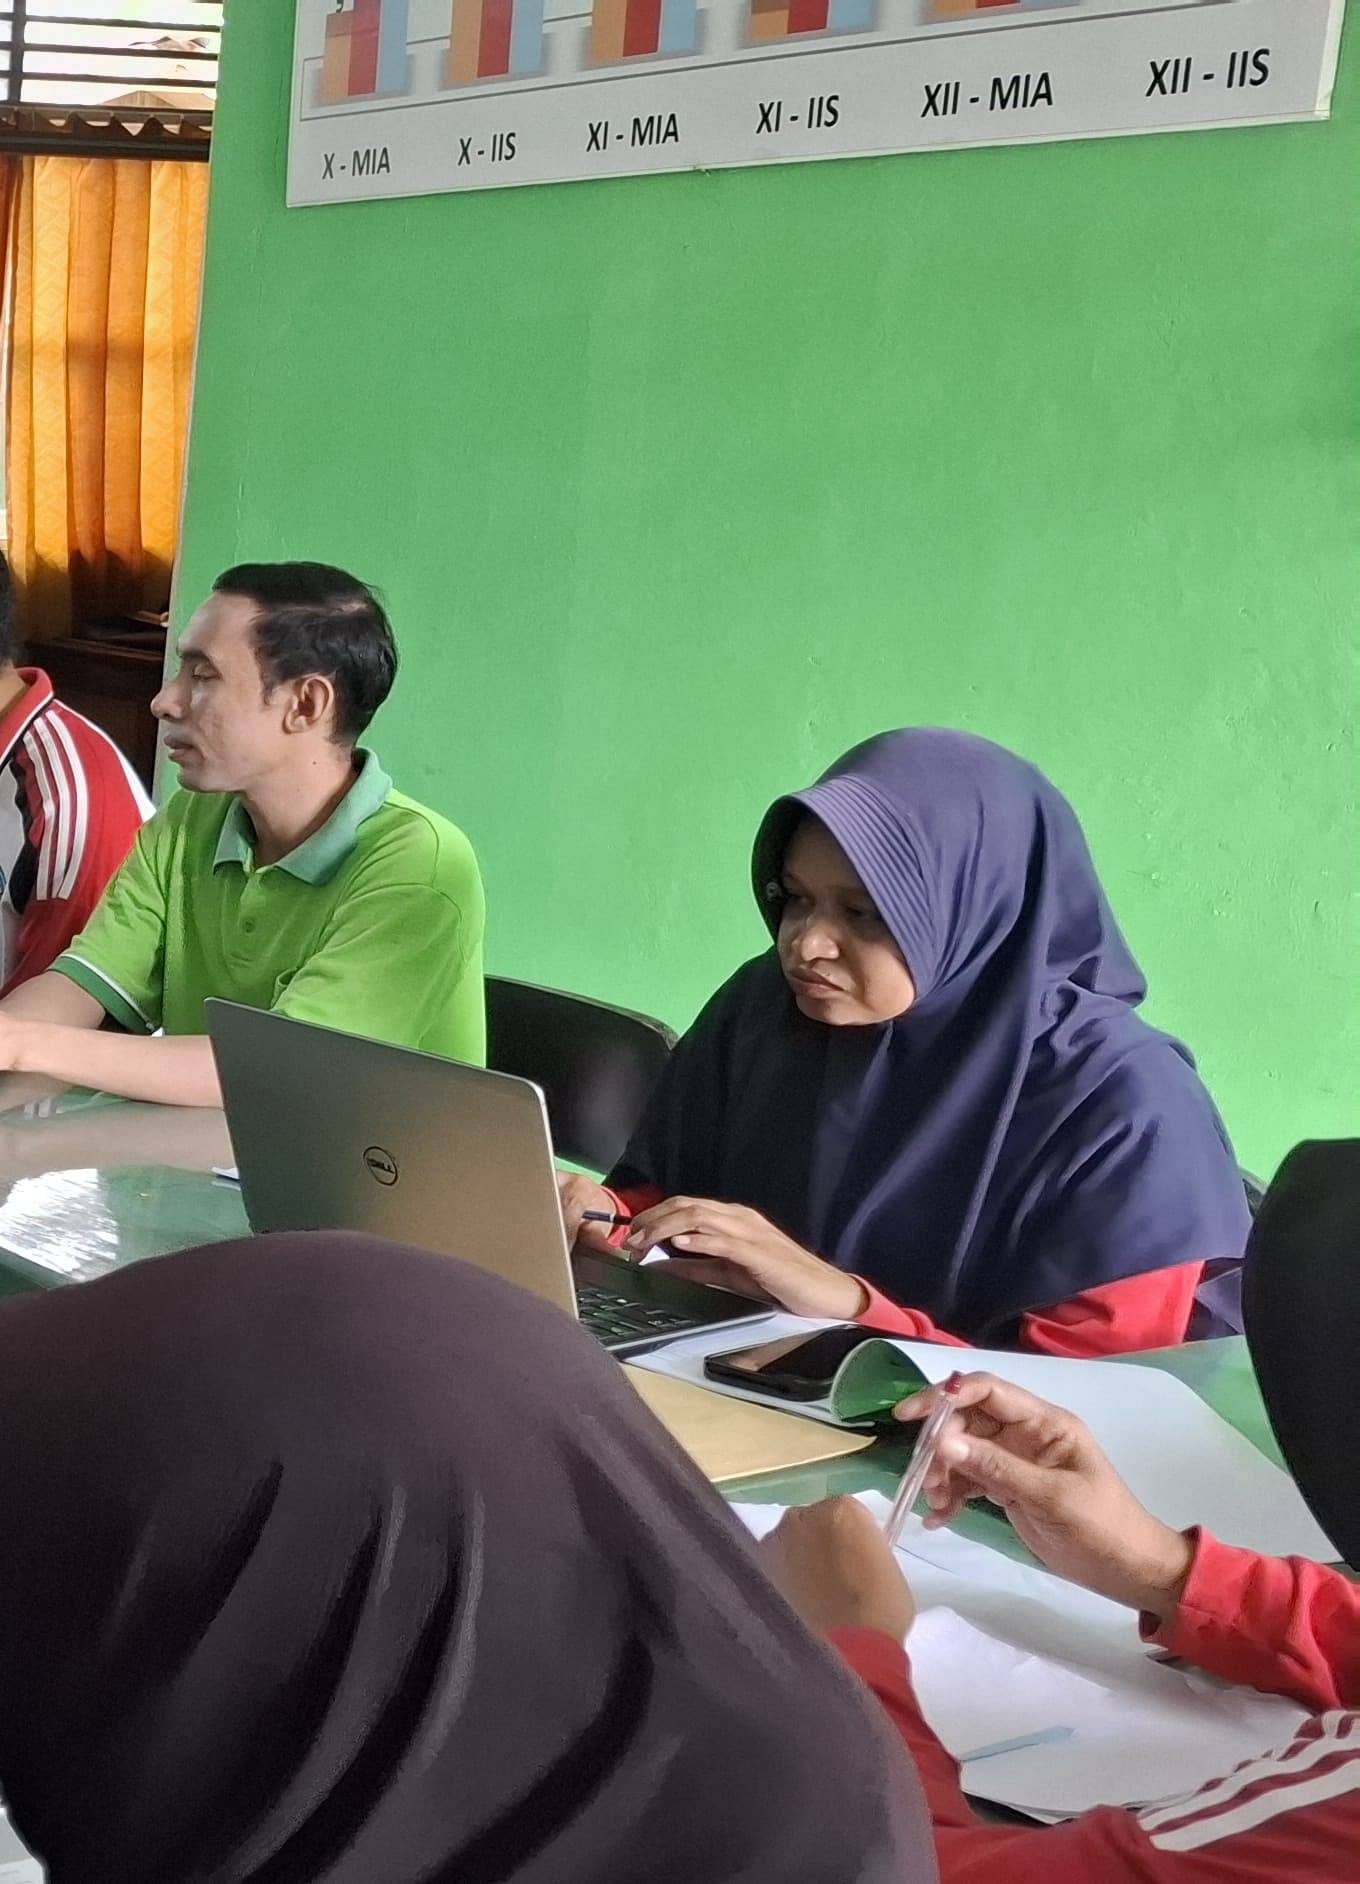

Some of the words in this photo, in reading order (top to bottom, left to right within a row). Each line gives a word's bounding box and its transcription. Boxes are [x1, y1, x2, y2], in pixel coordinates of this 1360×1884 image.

[1146, 58, 1191, 97] XII
[1227, 48, 1269, 88] IIS
[756, 101, 781, 134] XI
[808, 95, 840, 128] IIS
[921, 82, 960, 117] XII
[990, 73, 1053, 111] MIA
[458, 138, 472, 166] X
[492, 133, 516, 162] IIS
[587, 121, 608, 153] XI
[631, 114, 679, 147] MIA
[323, 153, 335, 180] X
[352, 148, 390, 177] MIA
[366, 1158, 394, 1174] DELL
